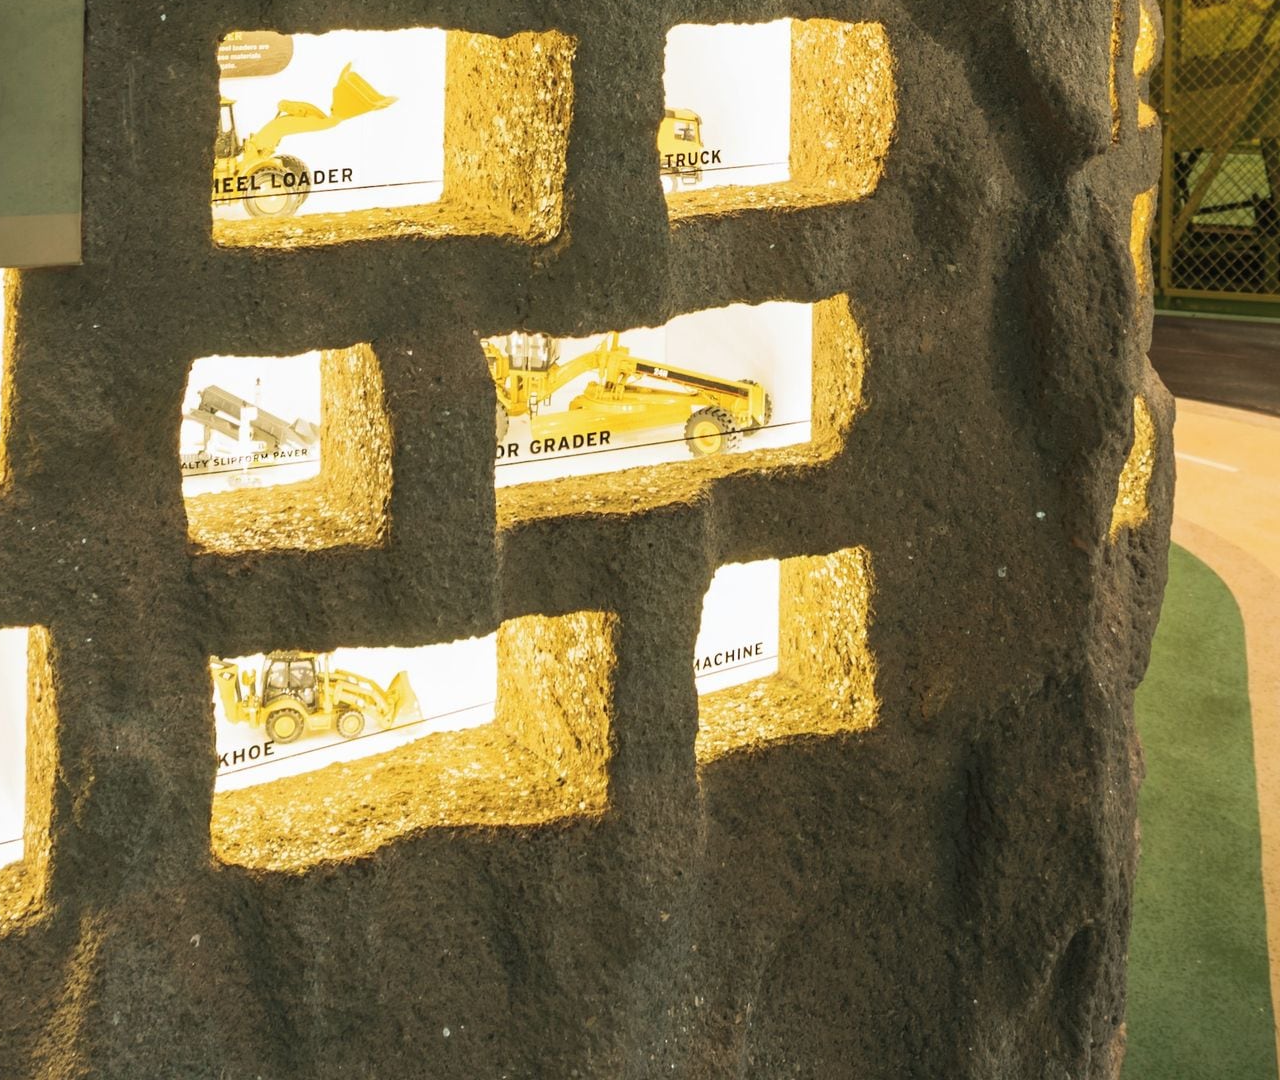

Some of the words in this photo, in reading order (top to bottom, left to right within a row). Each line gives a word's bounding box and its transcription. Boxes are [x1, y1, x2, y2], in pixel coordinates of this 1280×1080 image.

[664, 149, 722, 168] TRUCK
[271, 167, 354, 189] LOADER
[530, 430, 611, 455] GRADER
[213, 453, 268, 466] SLIPFORM
[273, 448, 308, 459] PAVER
[216, 740, 275, 769] KHOE
